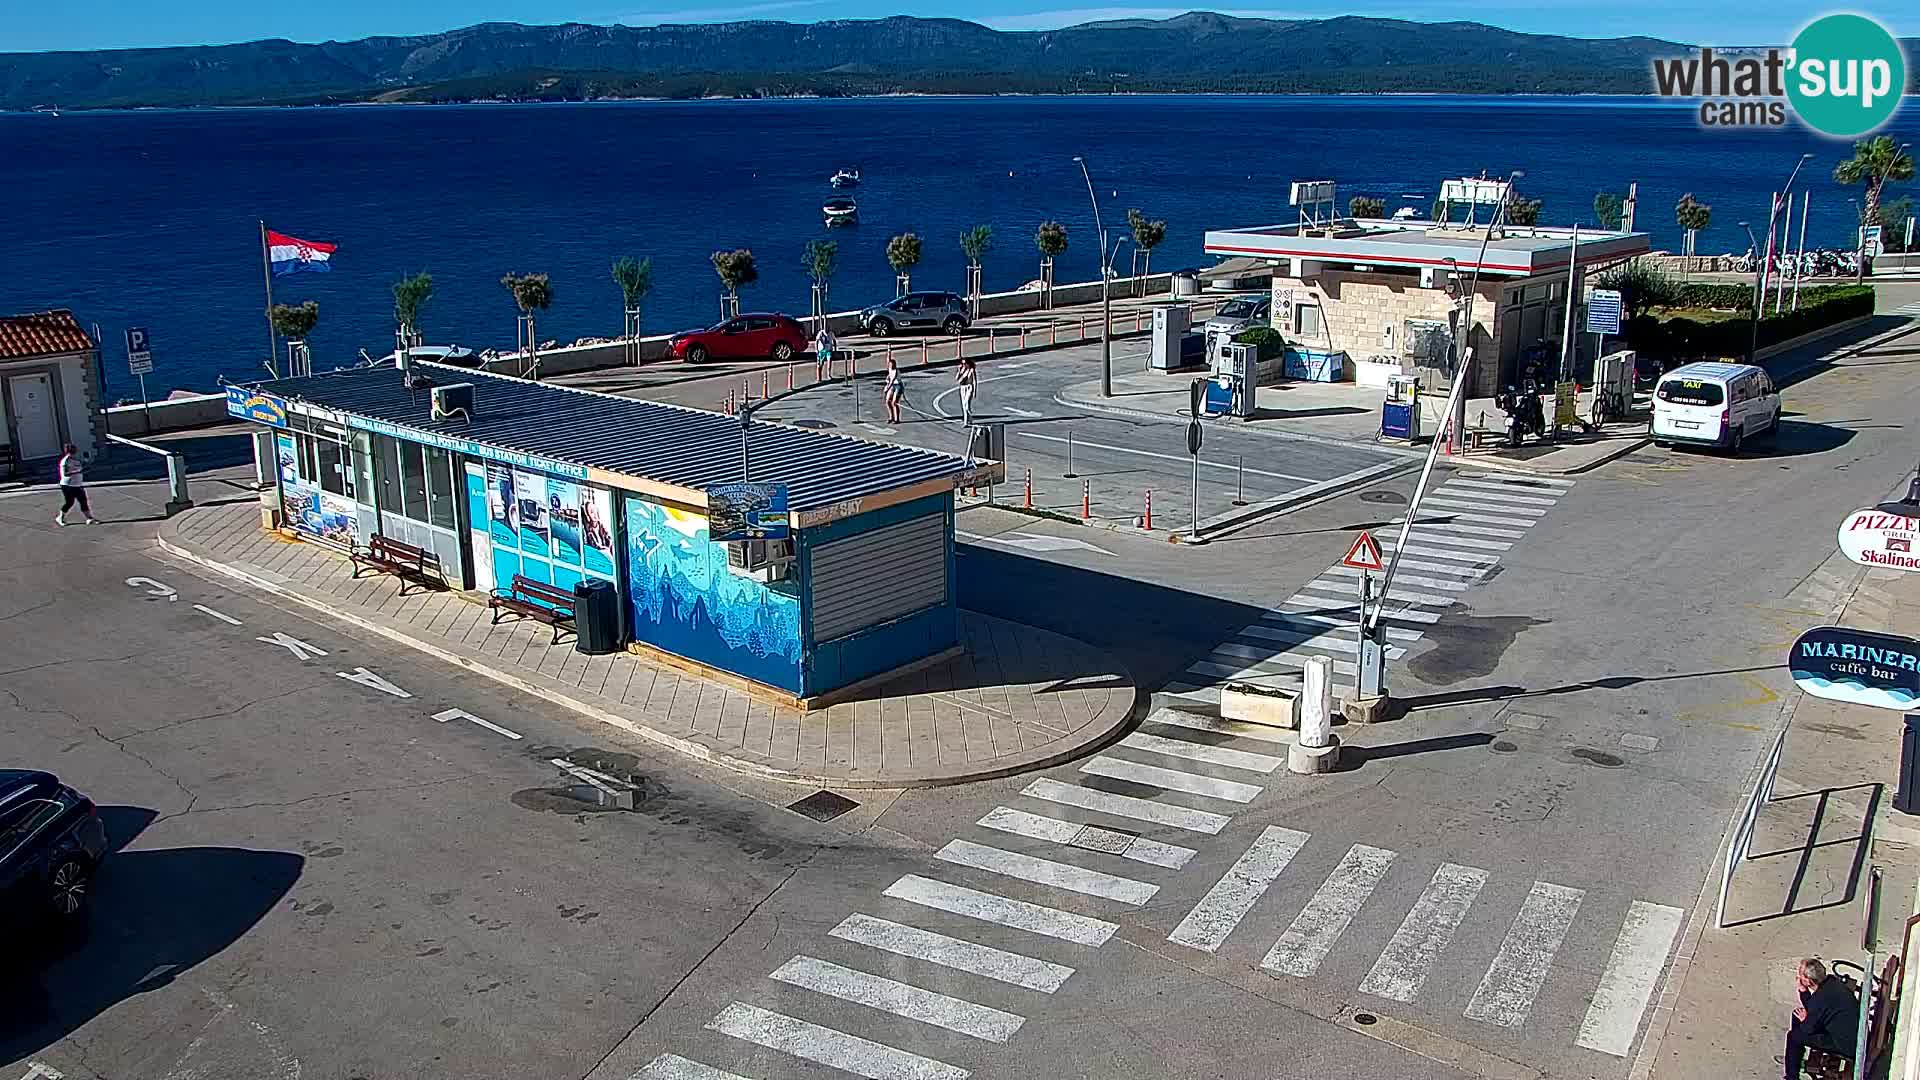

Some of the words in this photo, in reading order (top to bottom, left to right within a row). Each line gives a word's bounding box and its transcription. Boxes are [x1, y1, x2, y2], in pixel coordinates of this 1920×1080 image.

[131, 331, 143, 349] P
[1683, 381, 1701, 389] TAXI
[438, 436, 468, 452] POSTAJA
[479, 446, 495, 458] BUS
[495, 449, 527, 464] STATION
[530, 457, 556, 470] TICKET
[557, 463, 583, 476] OFFICE
[1849, 515, 1920, 533] PIZZE
[1801, 641, 1920, 674] MARINER
[1871, 665, 1898, 680] bar
